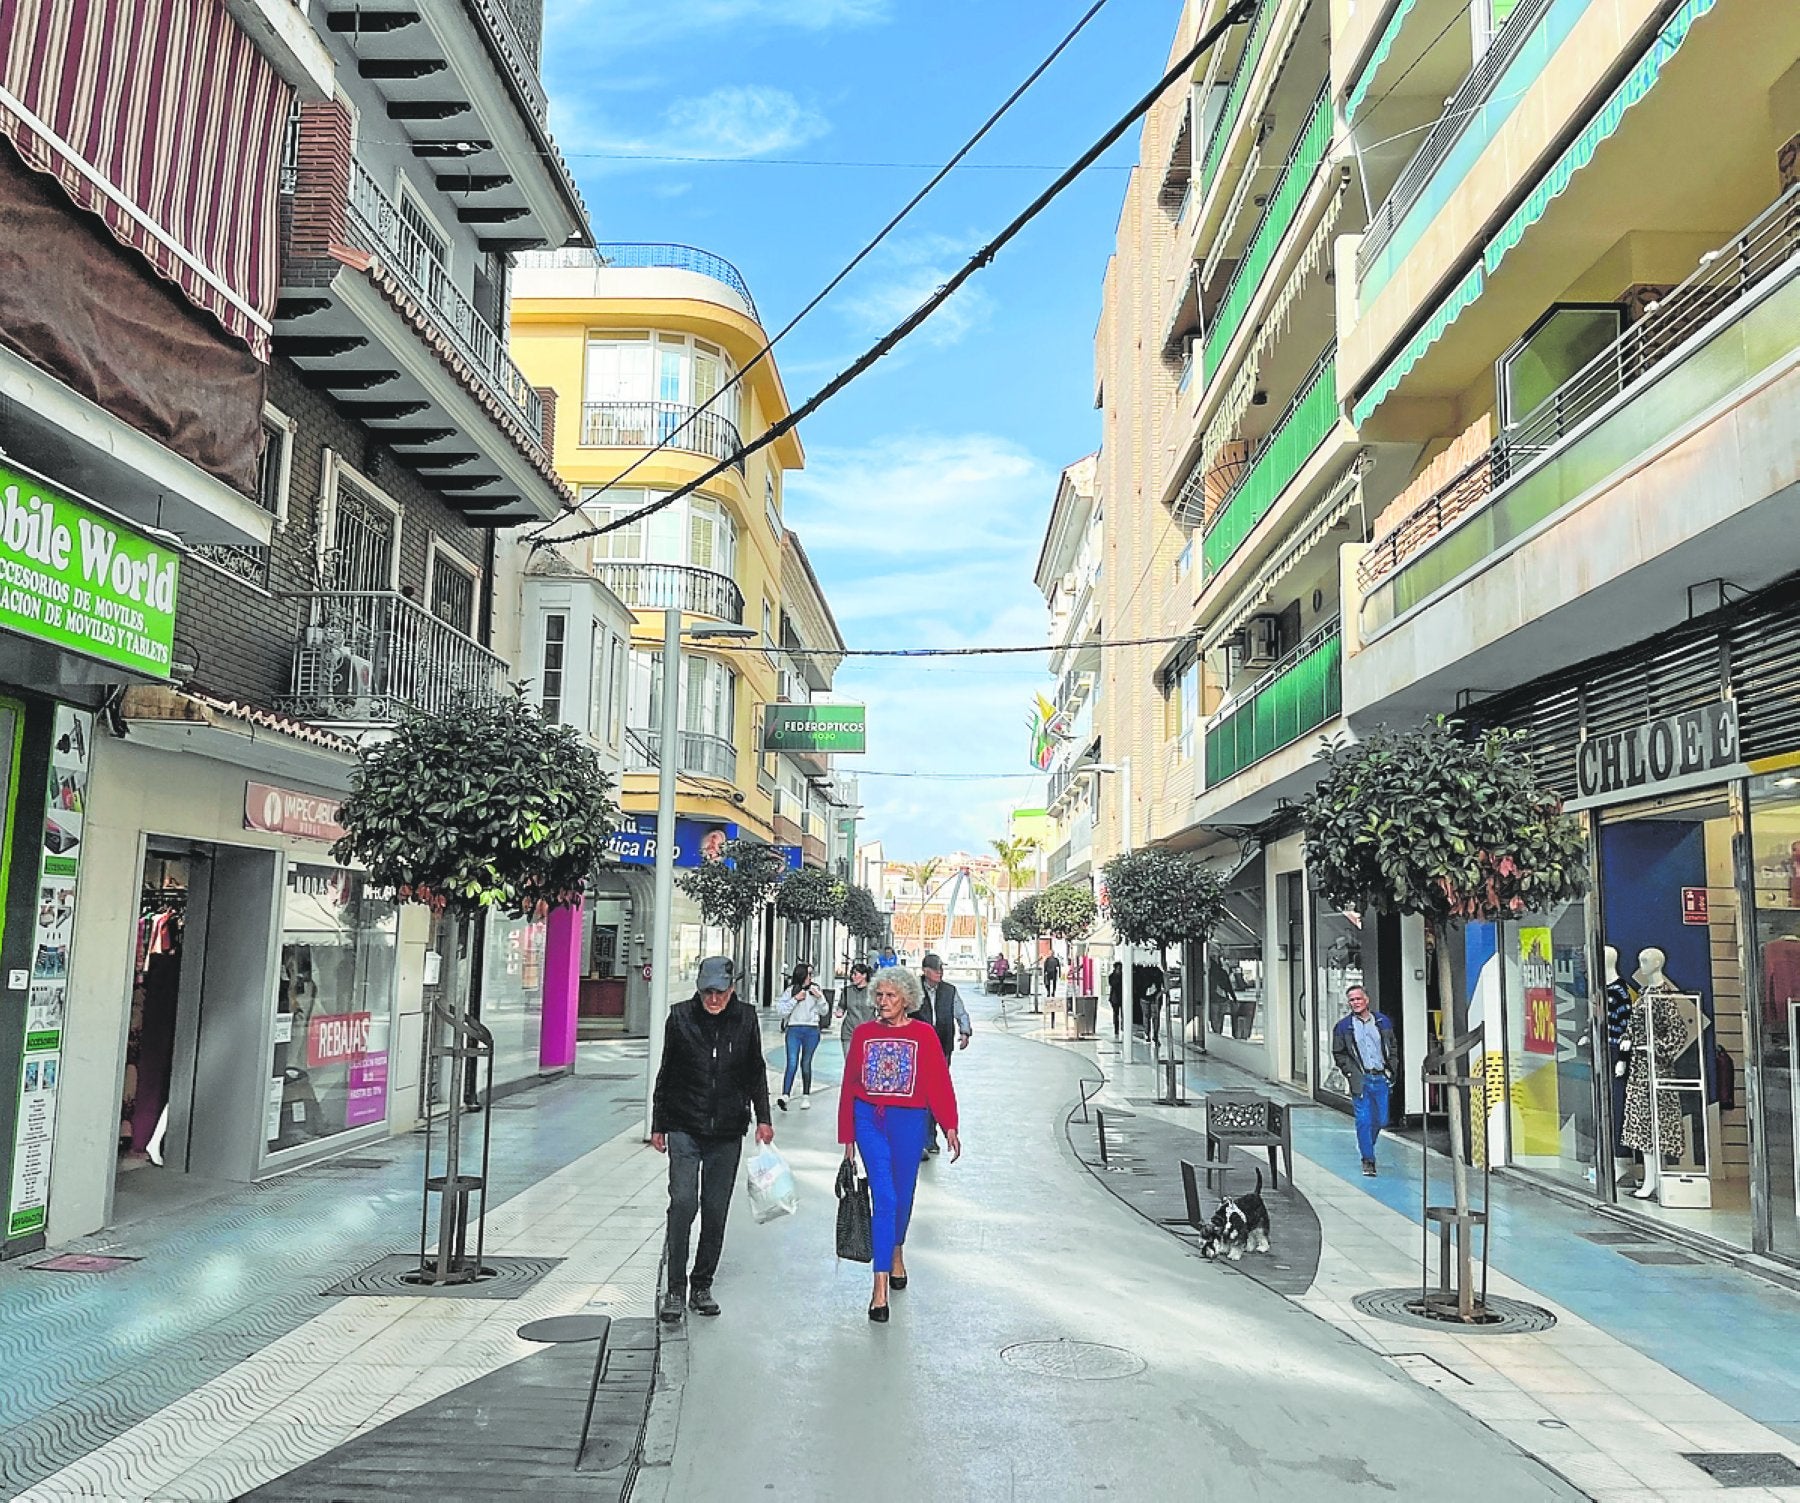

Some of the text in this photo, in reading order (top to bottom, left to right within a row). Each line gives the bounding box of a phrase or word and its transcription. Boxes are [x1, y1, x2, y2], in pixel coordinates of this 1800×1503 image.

[0, 485, 176, 614] bile World
[74, 588, 91, 612] DE
[0, 586, 168, 664] ACION DE MOVILES Y TABLETS
[784, 721, 864, 732] FEDEROPTICOS
[601, 835, 680, 859] tica Ro
[1554, 959, 1577, 1062] VIVE
[318, 1018, 371, 1058] REBAJAS
